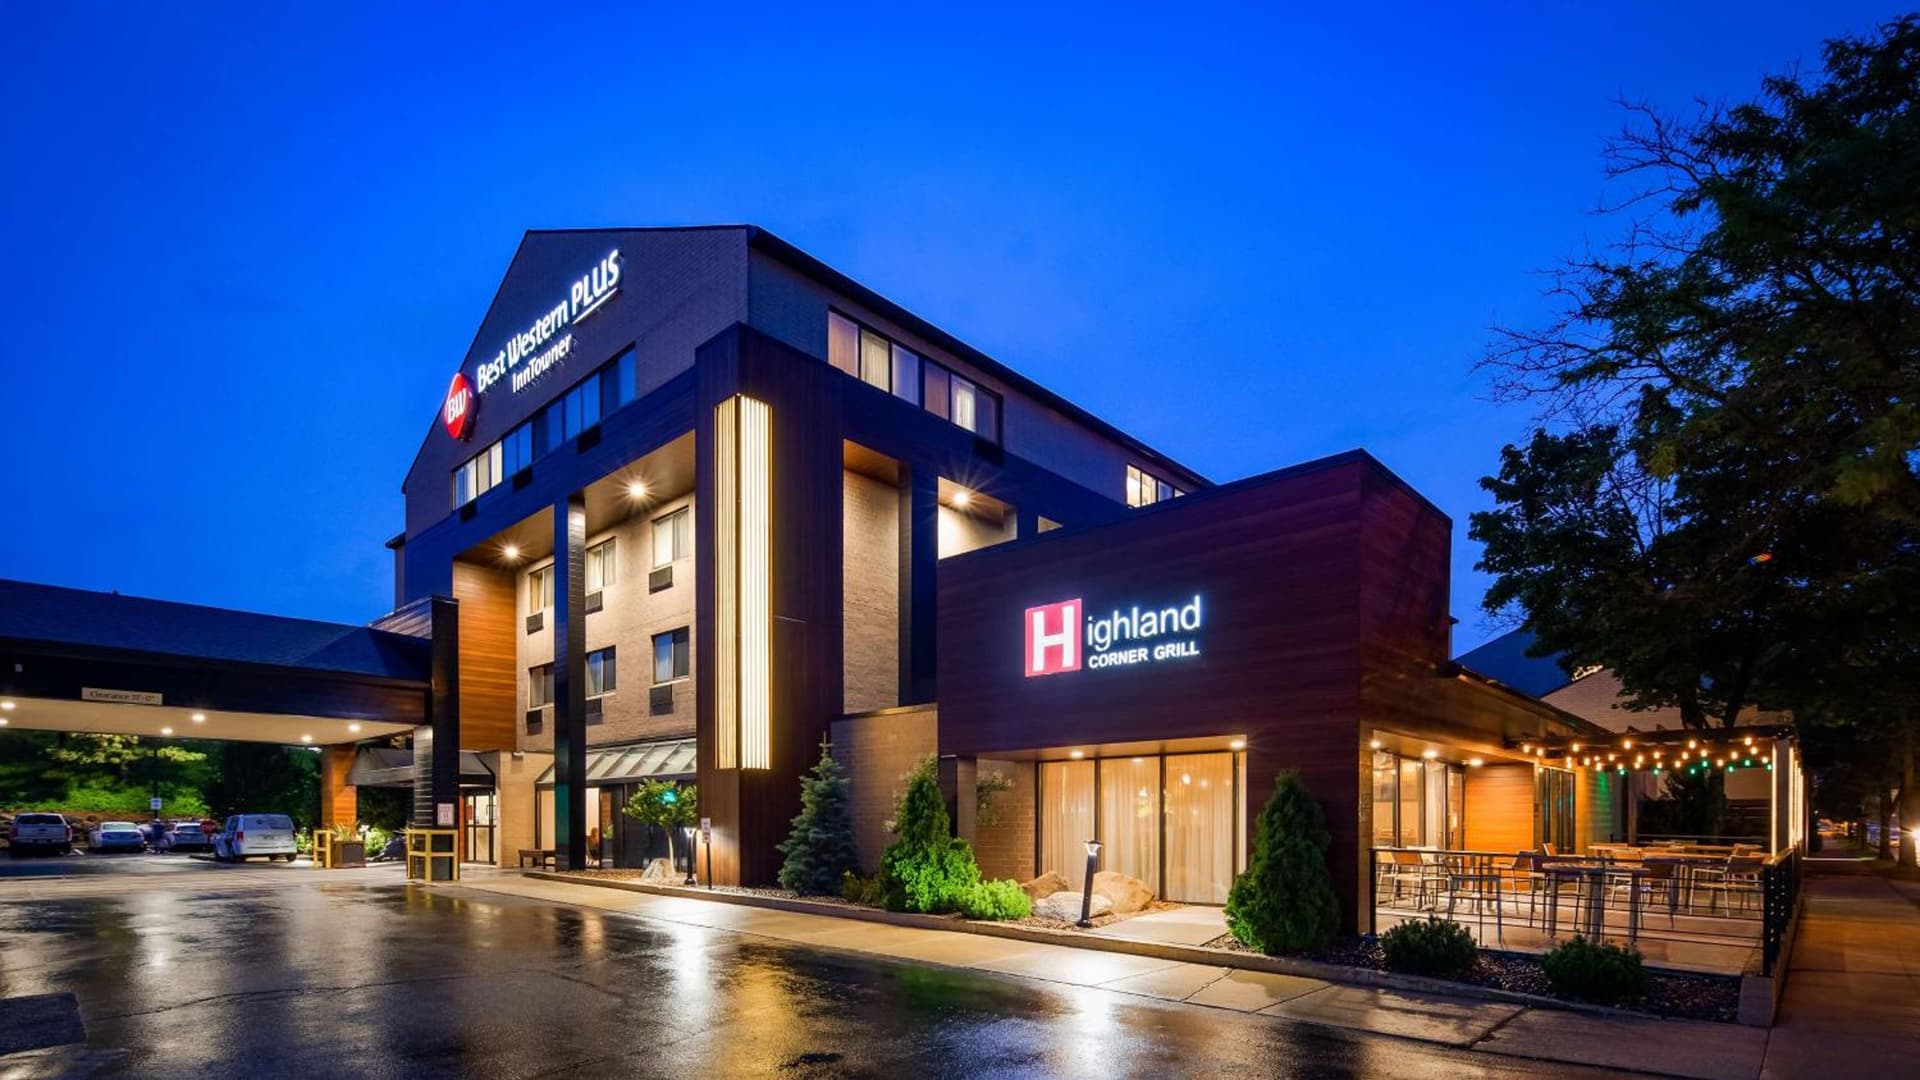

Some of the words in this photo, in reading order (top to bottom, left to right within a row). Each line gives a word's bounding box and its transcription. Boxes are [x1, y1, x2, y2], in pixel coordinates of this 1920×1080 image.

[477, 350, 506, 393] Best
[507, 299, 569, 369] Western
[571, 249, 620, 316] PLUS
[512, 333, 572, 393] InnTowner
[447, 388, 467, 425] BW
[1088, 648, 1148, 669] CORNER
[1154, 641, 1200, 660] GRILL
